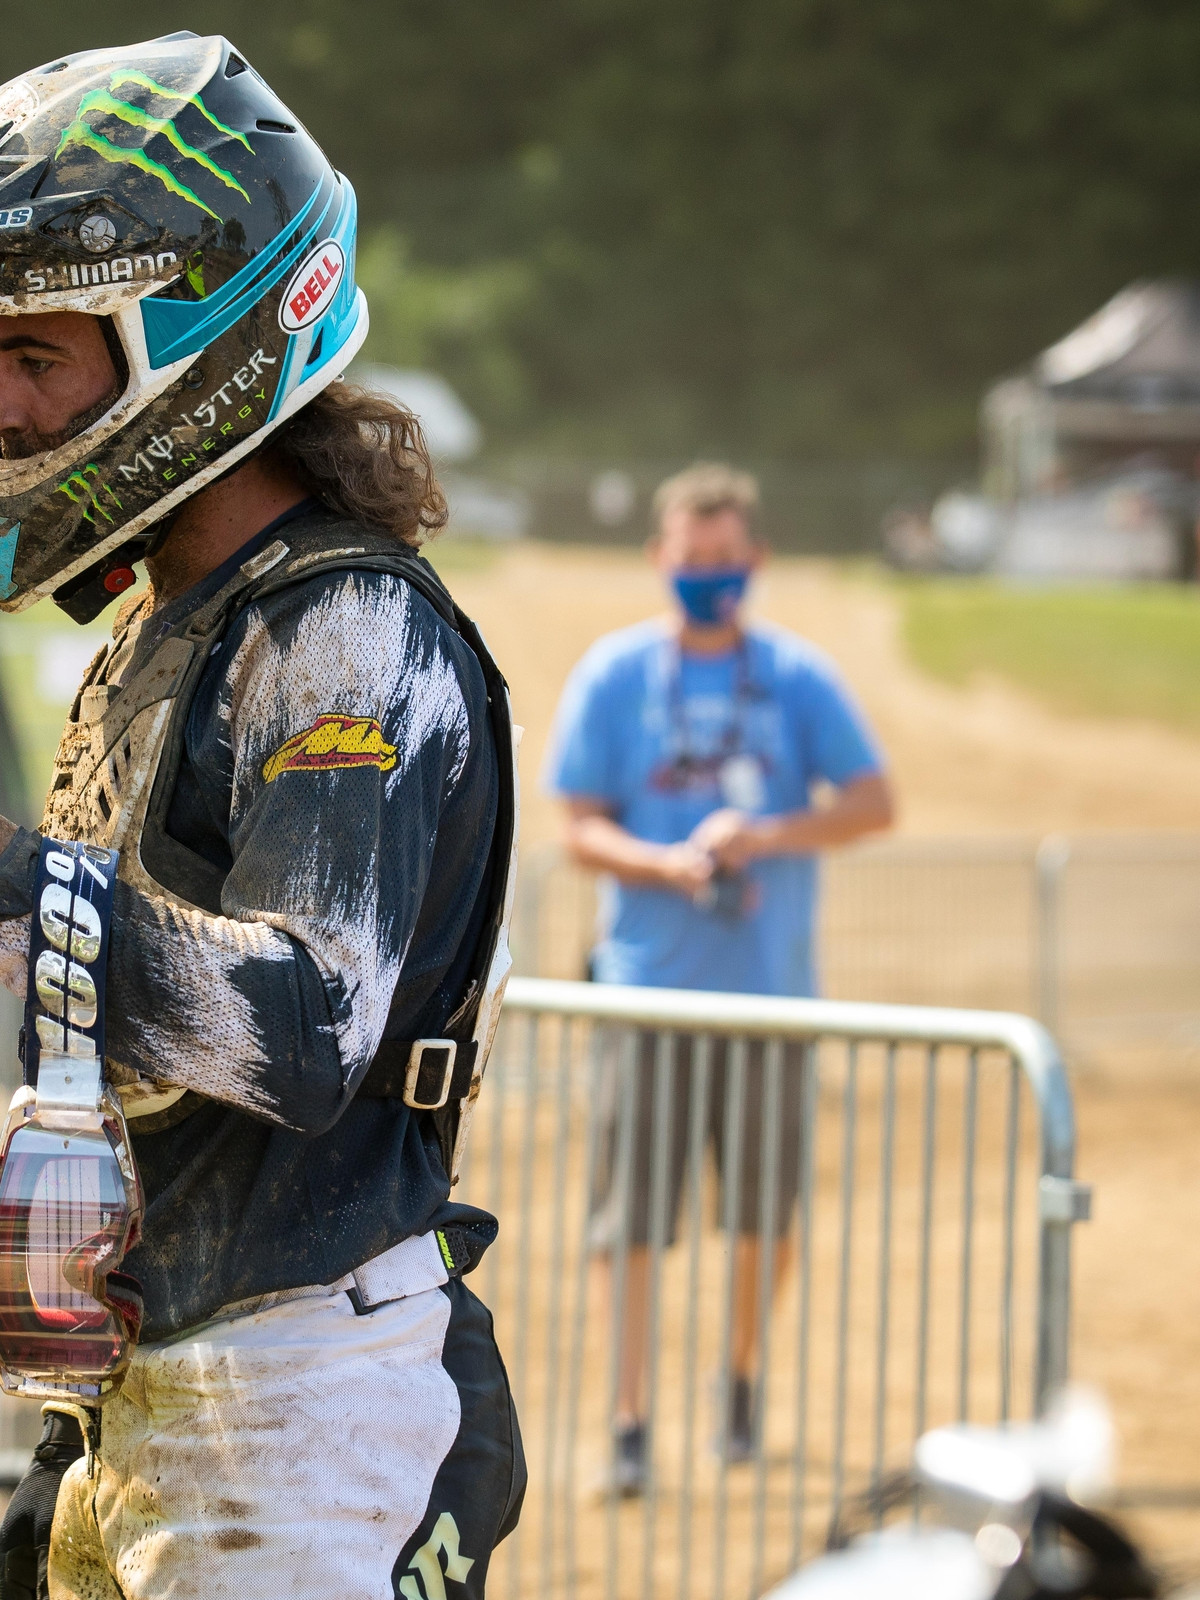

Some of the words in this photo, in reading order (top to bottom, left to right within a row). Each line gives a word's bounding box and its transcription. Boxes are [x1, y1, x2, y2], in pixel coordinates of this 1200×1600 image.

[289, 255, 340, 322] BELL
[162, 387, 266, 480] ENERGY
[35, 837, 111, 1057] 100%
